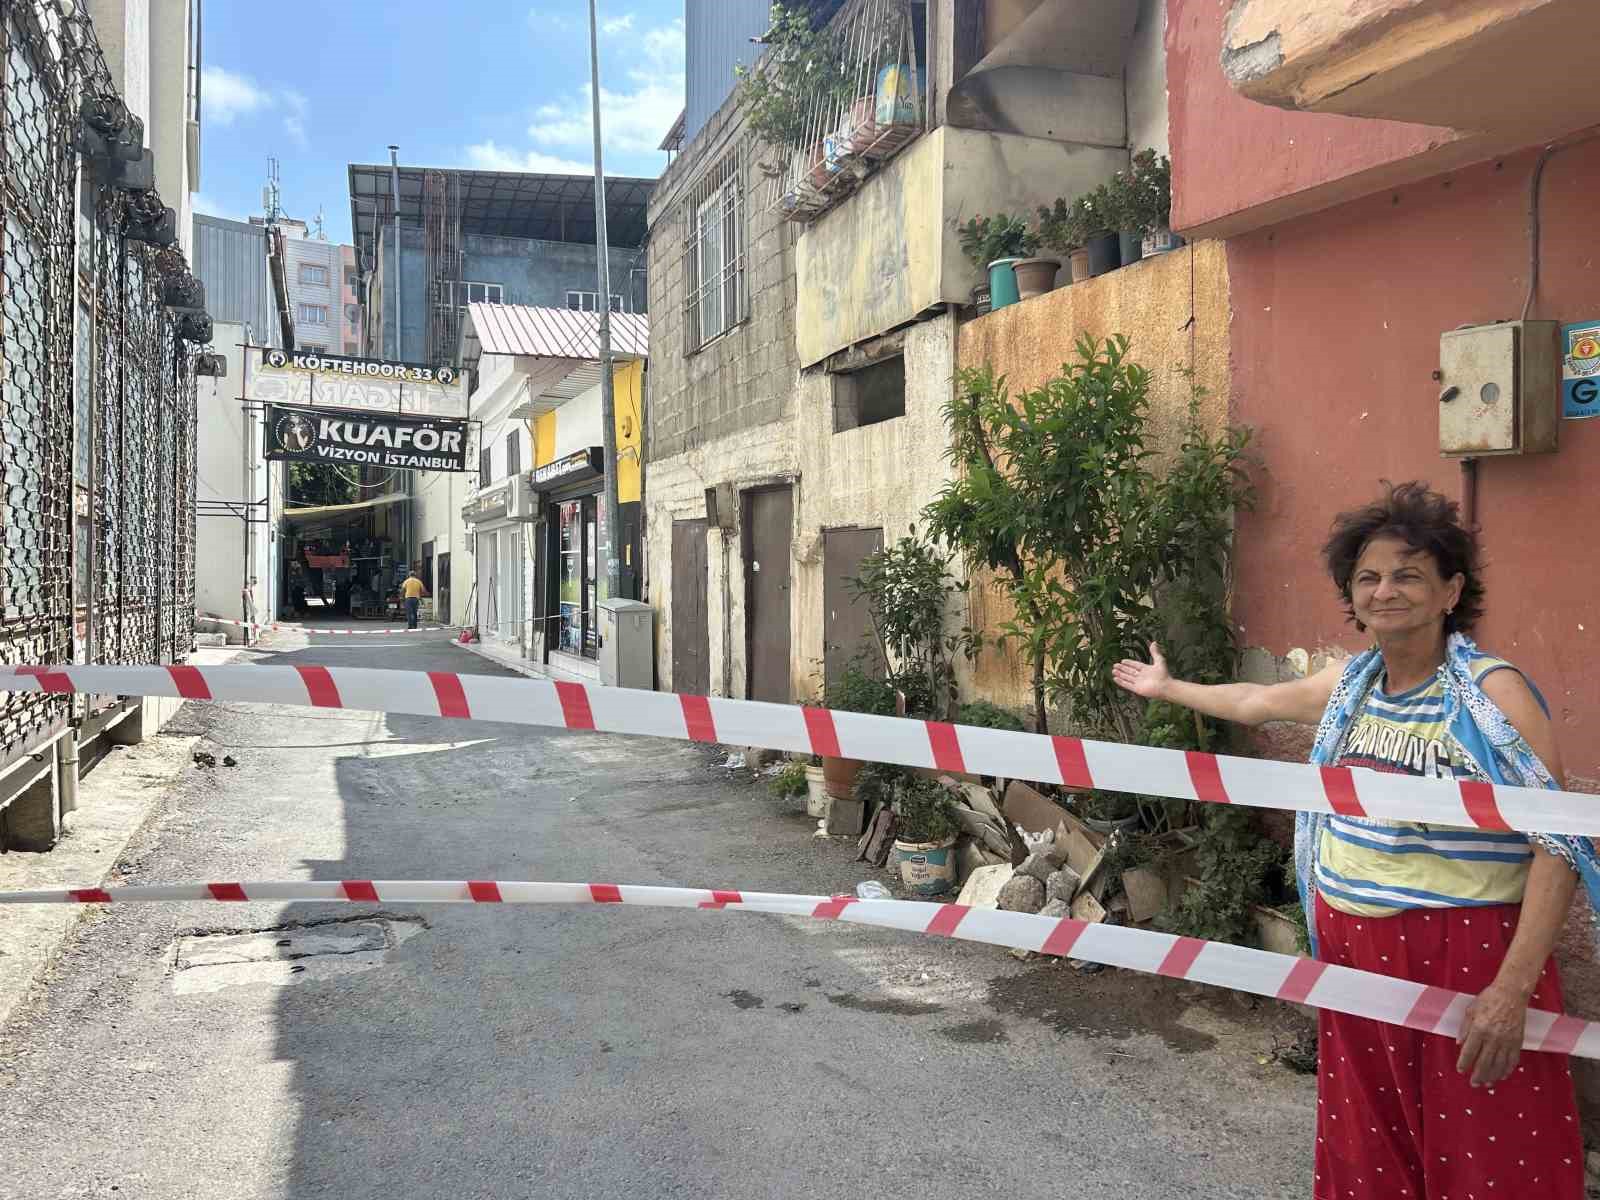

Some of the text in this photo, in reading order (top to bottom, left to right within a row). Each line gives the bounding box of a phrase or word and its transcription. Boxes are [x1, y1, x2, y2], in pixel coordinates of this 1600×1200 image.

[413, 370, 433, 381] 33
[319, 418, 462, 453] KUAFÖR
[317, 445, 461, 470] VİZYON İSTANBUL
